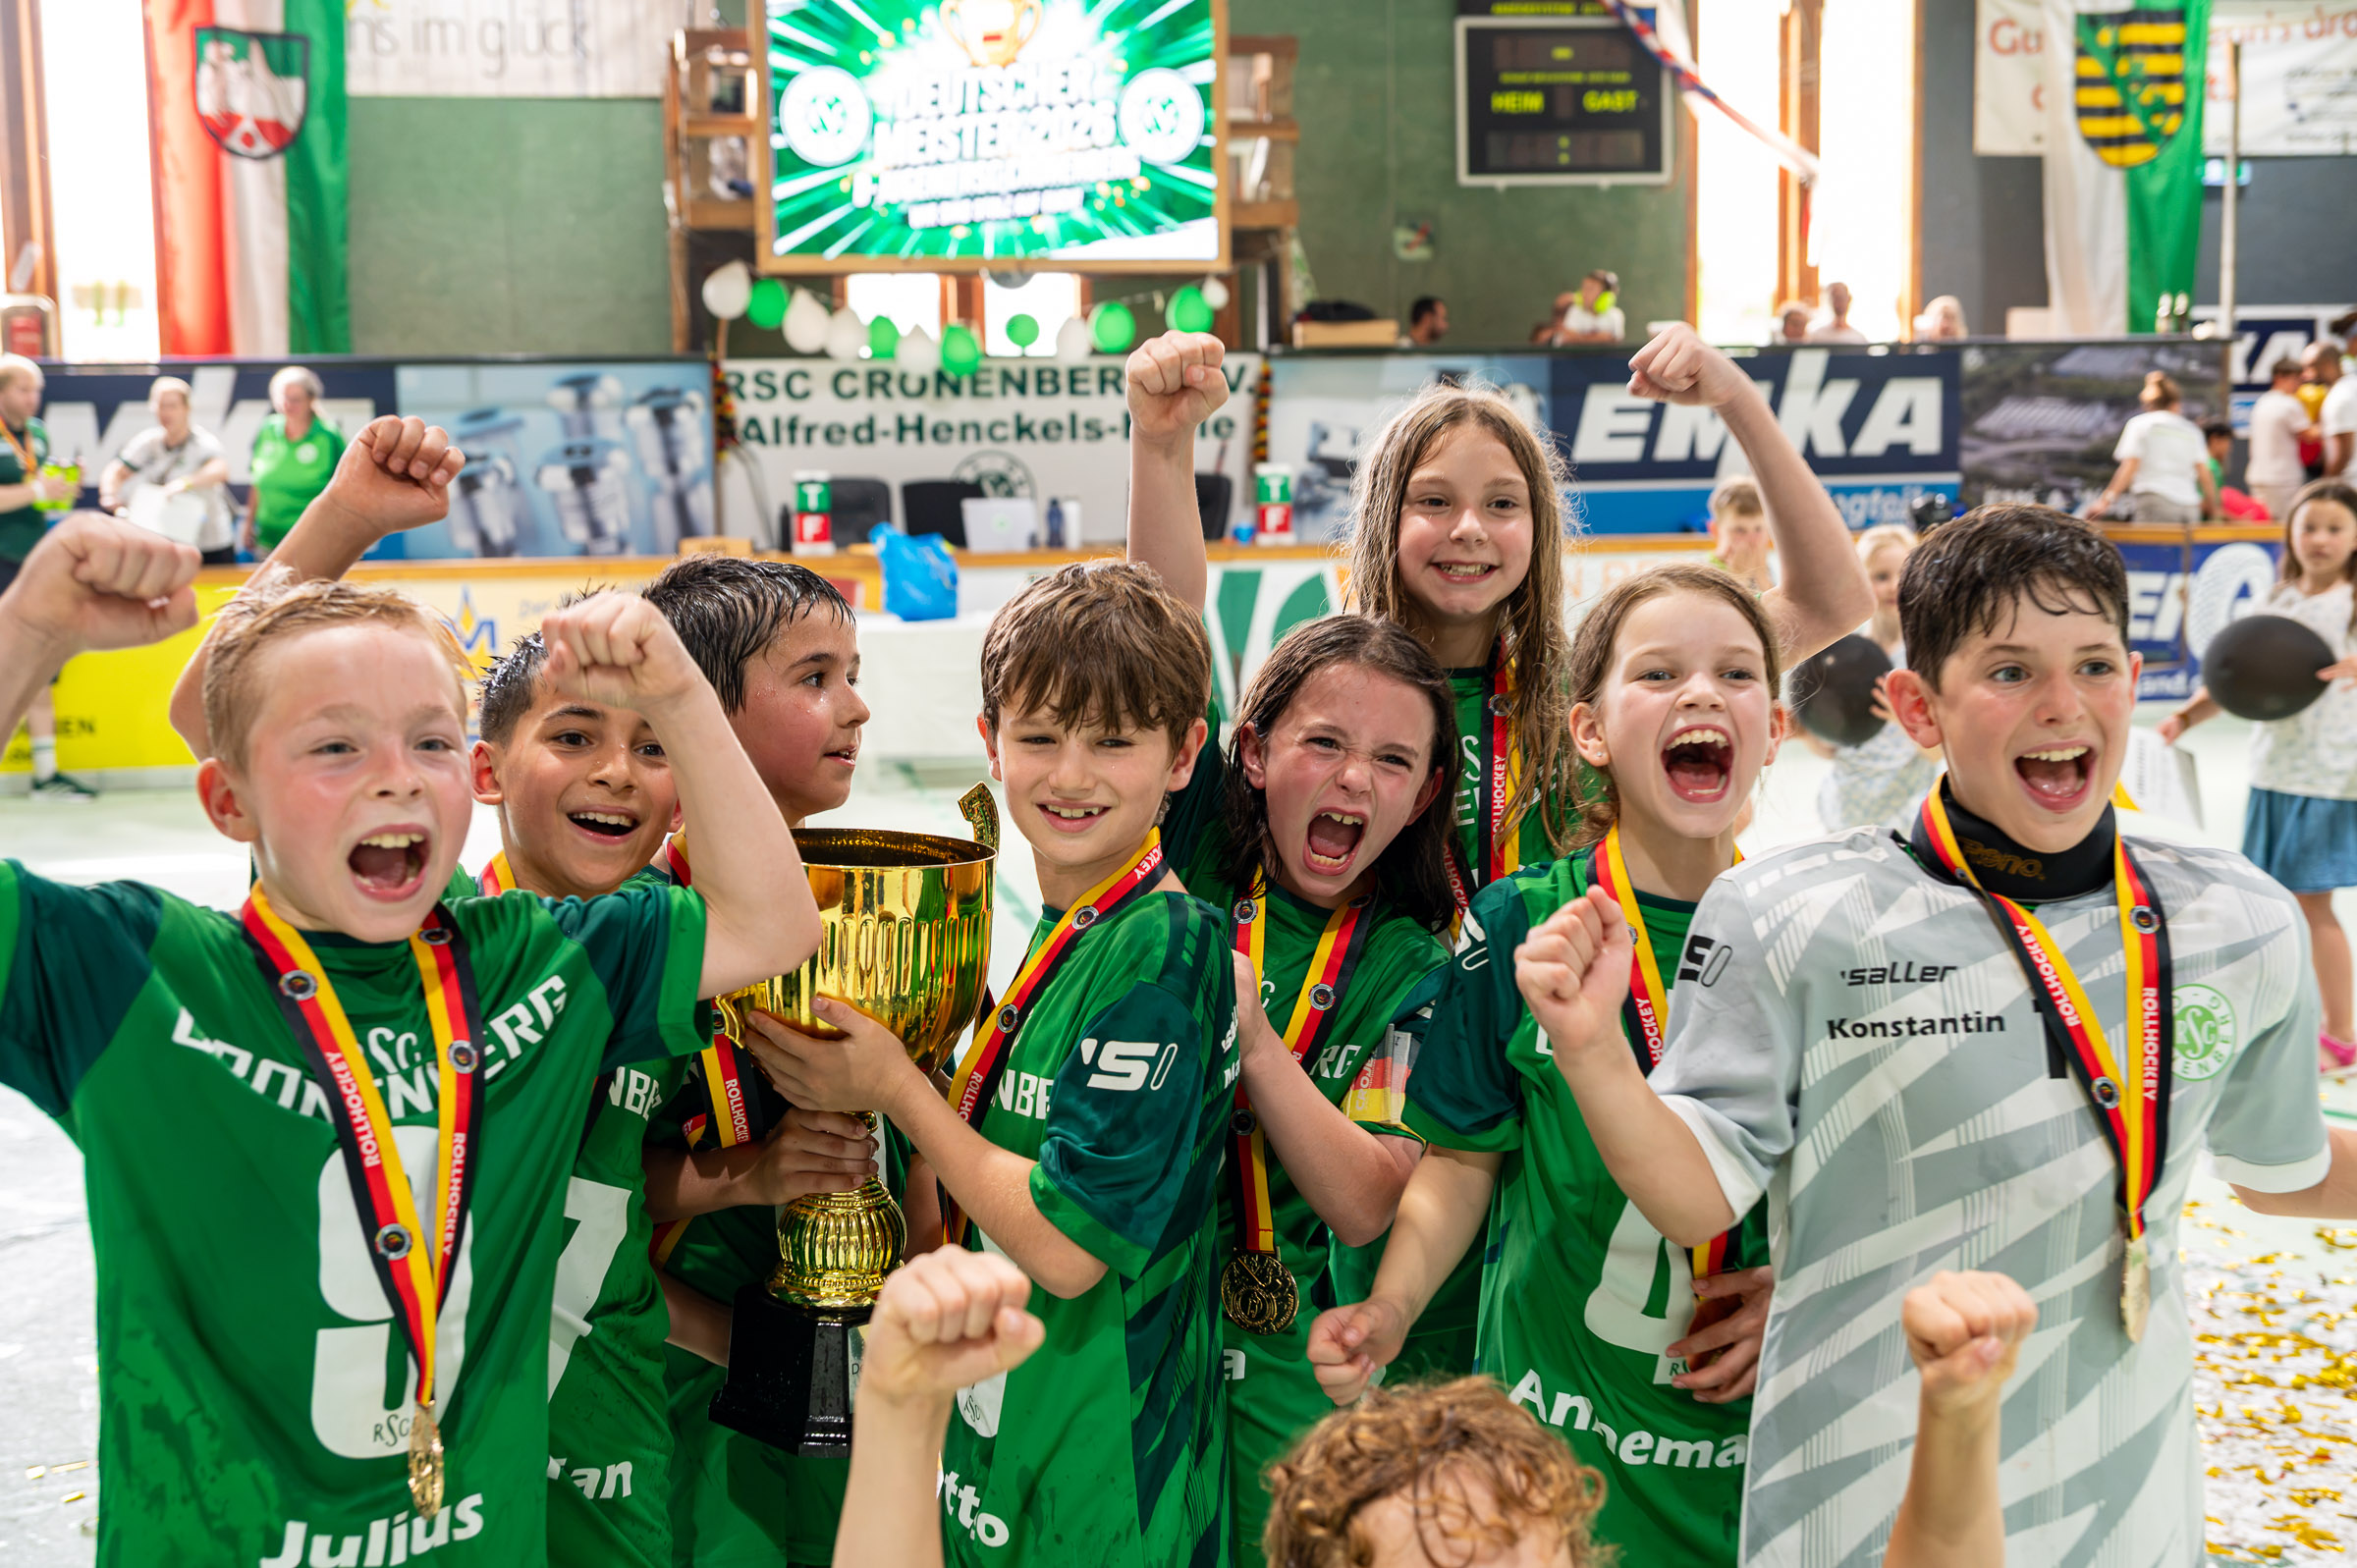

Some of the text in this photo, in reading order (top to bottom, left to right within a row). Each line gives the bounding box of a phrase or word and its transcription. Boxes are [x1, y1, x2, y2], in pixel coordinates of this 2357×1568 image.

[895, 60, 1095, 120] DEUTSCHER
[1491, 89, 1638, 114] HEIM GAST
[874, 110, 1019, 167] MEISTER
[725, 369, 811, 402] RSC
[831, 363, 1125, 401] CRONENBER
[743, 408, 1234, 445] Alfred-Henckels-le
[1493, 754, 1507, 837] OLLHOCKEY
[2016, 924, 2081, 1027] ROLLHOCKEY
[357, 1027, 421, 1075] SC
[1827, 1010, 2005, 1040] Konstantin
[2142, 987, 2159, 1101] ROLLHOCKEY
[326, 1052, 381, 1168] ROLLHOCKEY
[725, 1078, 749, 1143] ROLLHOCKE
[443, 1132, 466, 1256] ROLLHOCKEY
[259, 1492, 484, 1568] Julius
[944, 1470, 1011, 1548] tto
